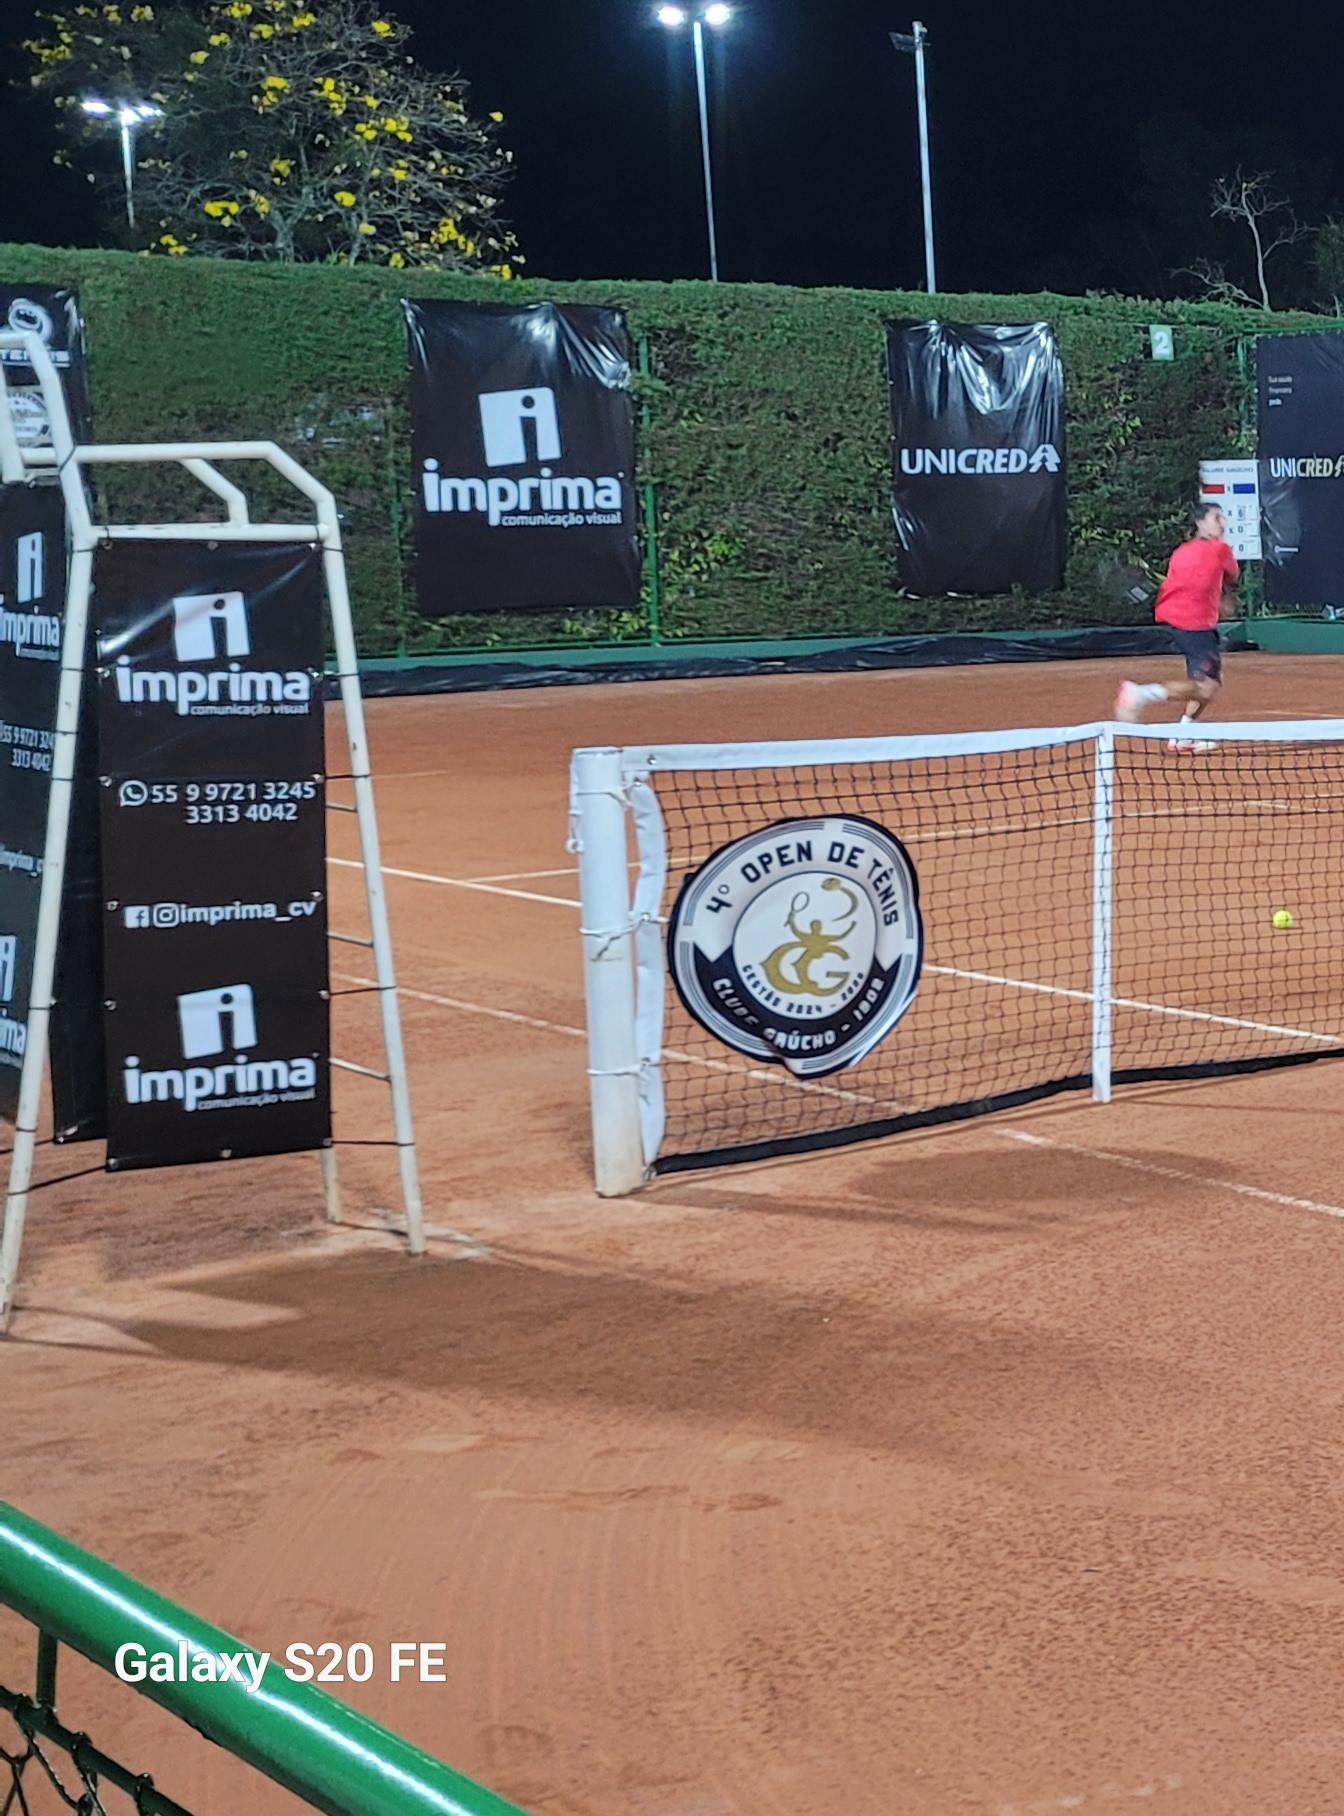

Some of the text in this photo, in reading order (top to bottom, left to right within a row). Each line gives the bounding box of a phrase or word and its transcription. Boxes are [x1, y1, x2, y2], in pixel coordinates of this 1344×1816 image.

[1154, 333, 1170, 354] 2
[901, 449, 1027, 474] UNICRED
[1269, 457, 1334, 477] UNICRED
[422, 457, 622, 527] imprima
[502, 512, 622, 528] comunicação visual
[0, 593, 60, 657] imprima
[116, 655, 311, 716] imprima
[190, 703, 310, 717] comunicação visual
[151, 781, 317, 803] 55 9 9721 3245
[185, 803, 298, 824] 3313 4042
[741, 841, 813, 883] OPEN
[827, 841, 865, 869] DE
[867, 858, 899, 926] TÊNIS
[180, 901, 316, 926] imprima_cv
[763, 1027, 836, 1051] GAÚCHO
[124, 1055, 317, 1112] imprima
